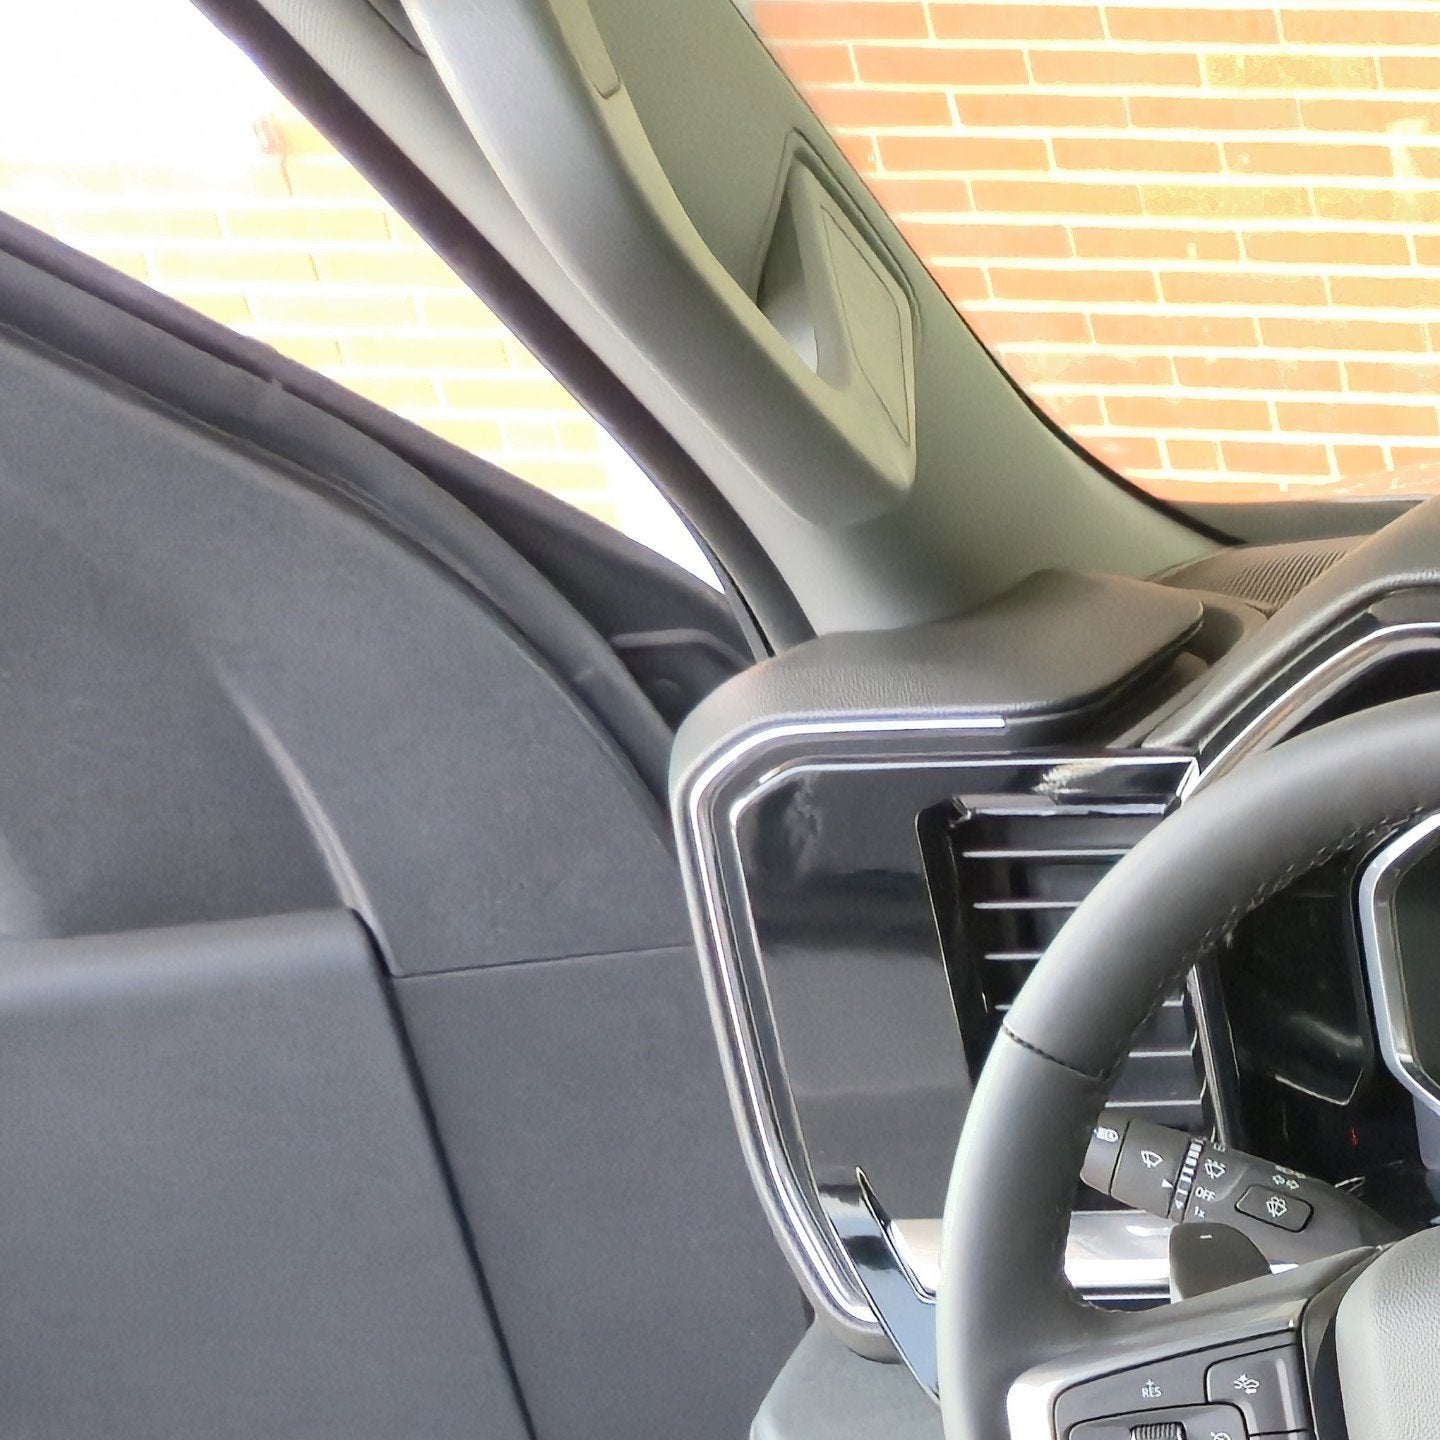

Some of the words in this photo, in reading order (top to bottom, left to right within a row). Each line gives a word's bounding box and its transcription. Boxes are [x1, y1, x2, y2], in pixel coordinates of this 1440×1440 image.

[1195, 1187, 1215, 1201] OFF
[1193, 1206, 1205, 1218] 1x
[1141, 1387, 1162, 1399] RES
